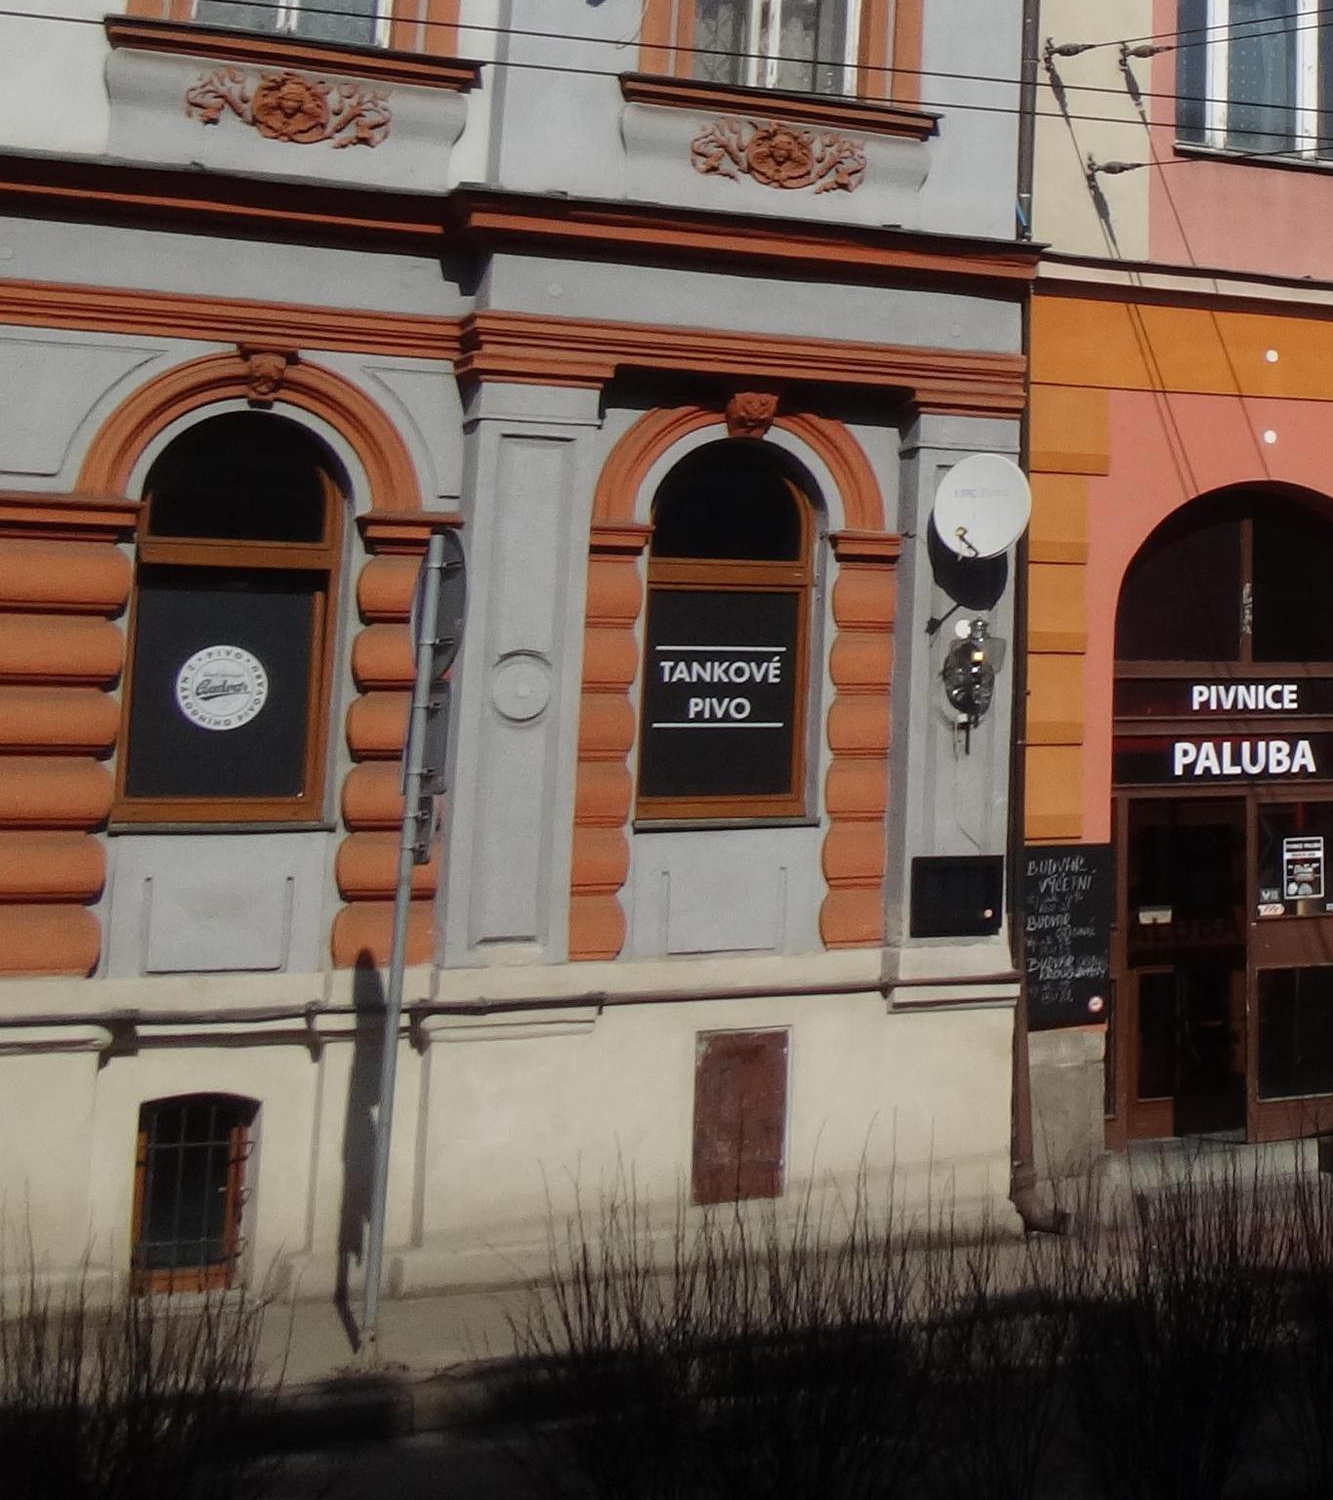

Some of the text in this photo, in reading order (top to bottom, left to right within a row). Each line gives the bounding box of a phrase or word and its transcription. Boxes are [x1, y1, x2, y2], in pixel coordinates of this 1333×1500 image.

[659, 656, 782, 684] TANKOVÉ
[688, 698, 751, 719] PIVO
[1192, 684, 1298, 711] PIVNICE
[1174, 740, 1317, 776] PALUBA
